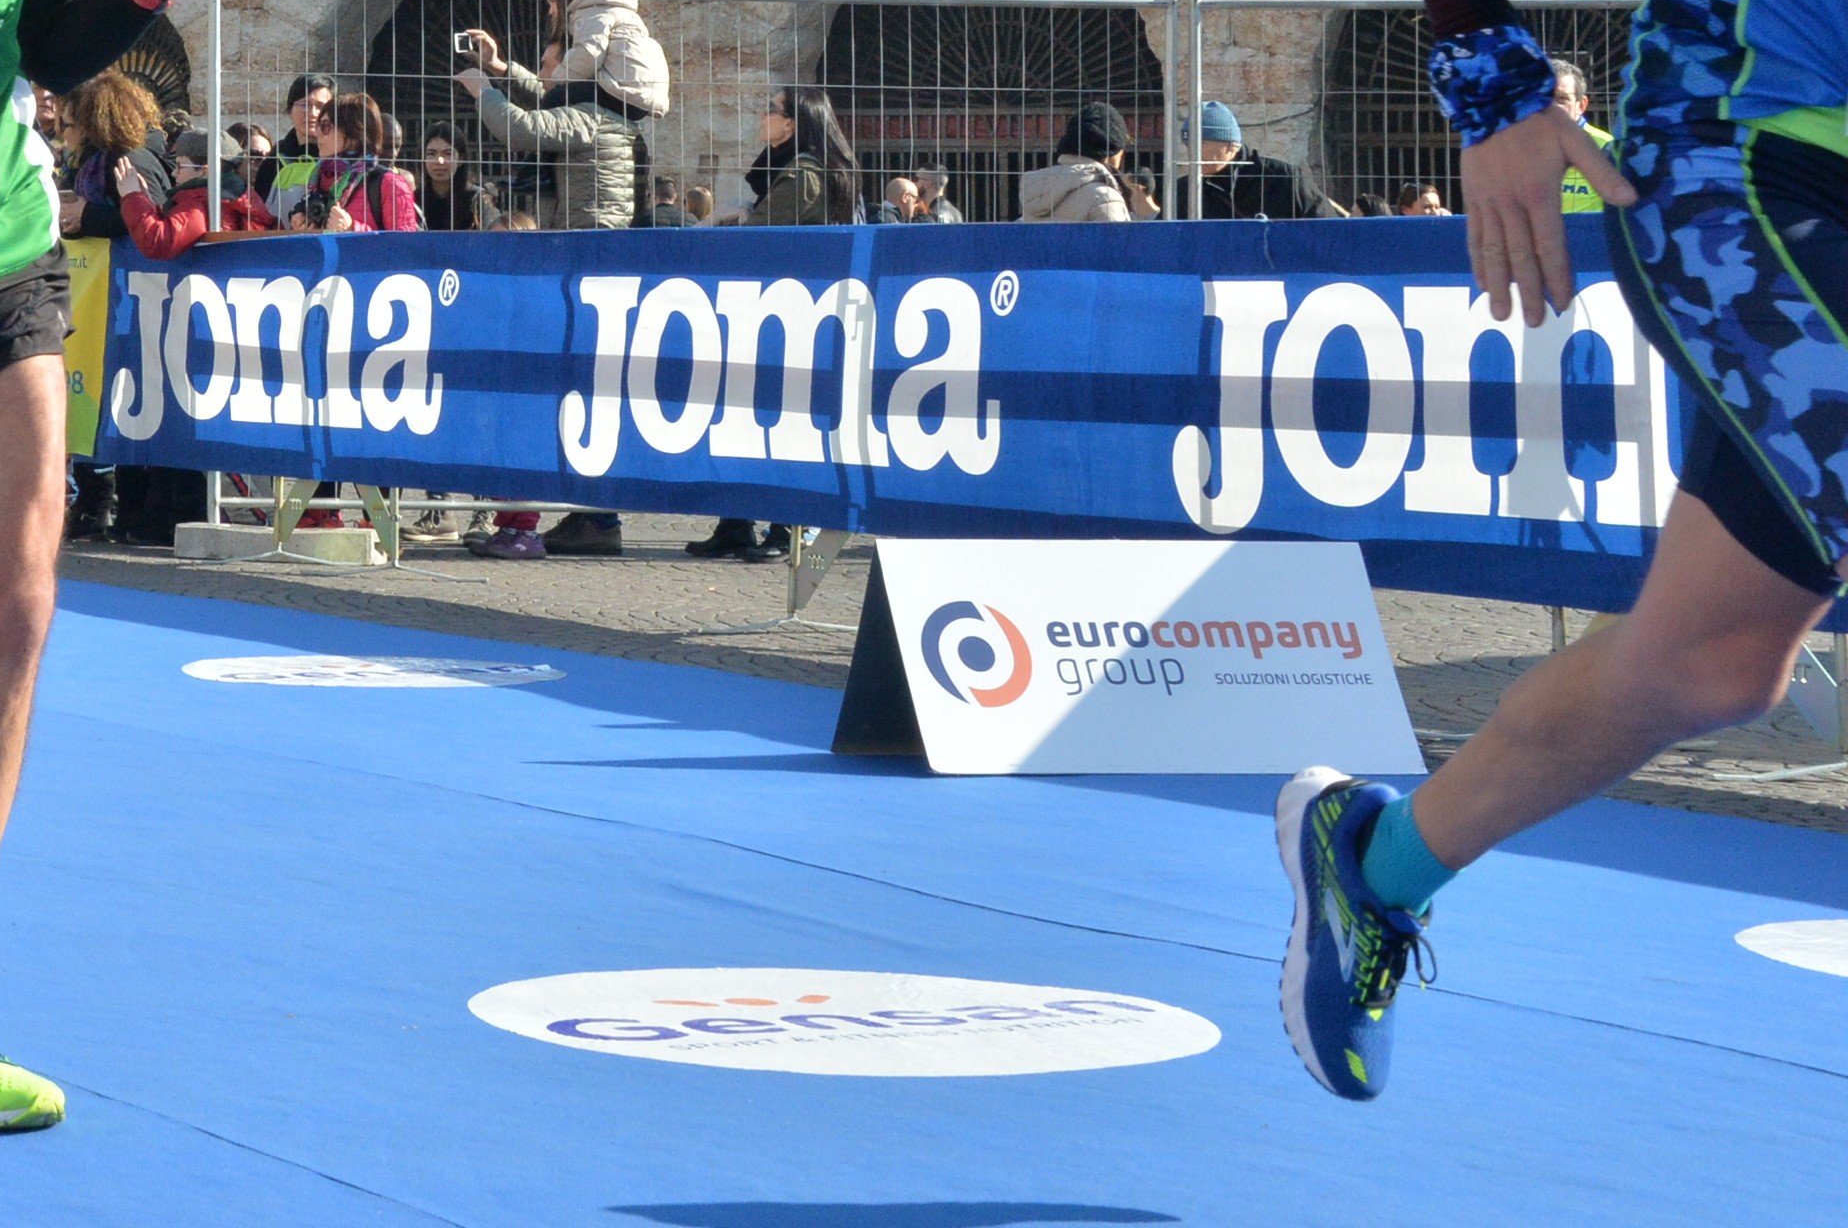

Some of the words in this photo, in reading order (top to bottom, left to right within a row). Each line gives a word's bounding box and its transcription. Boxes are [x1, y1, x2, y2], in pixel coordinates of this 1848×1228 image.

[1172, 280, 1680, 534] Jom
[1045, 620, 1362, 660] eurocompany
[1055, 657, 1186, 696] group
[1214, 672, 1291, 686] SOLUZIONI
[1293, 672, 1374, 686] LOGISTICHE
[545, 998, 1156, 1042] Gensan
